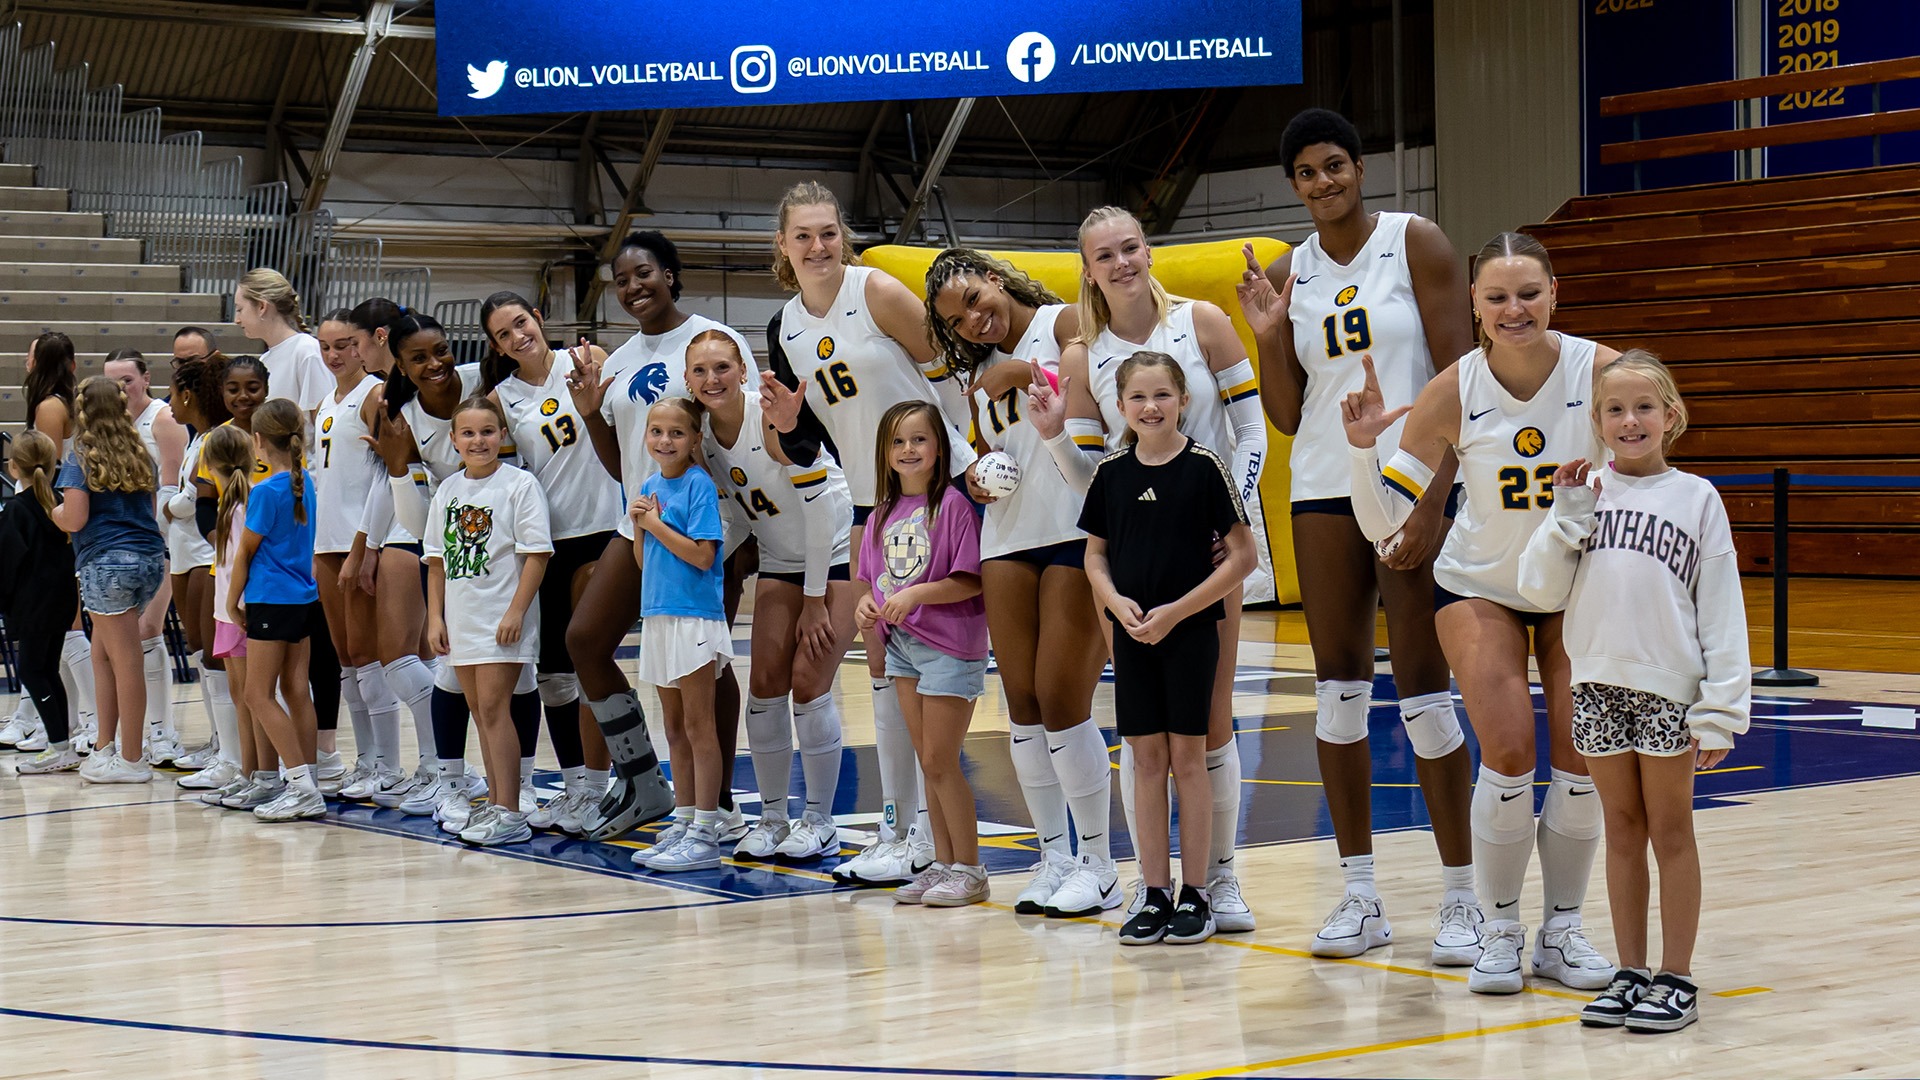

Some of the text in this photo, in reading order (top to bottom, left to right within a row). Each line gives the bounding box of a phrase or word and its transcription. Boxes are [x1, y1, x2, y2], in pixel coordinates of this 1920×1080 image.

[1779, 18, 1840, 48] 2019
[787, 50, 990, 78] @LIONVOLLEYBALL
[1070, 37, 1273, 66] /LIONVOLLEYBALL
[1779, 50, 1839, 75] 2021
[514, 61, 724, 88] @LION_VOLLEYBALL
[1779, 86, 1845, 111] 2022
[1322, 306, 1374, 360] 19
[815, 360, 859, 406] 16
[987, 386, 1021, 436] 17
[540, 413, 579, 454] 13
[321, 437, 332, 469] 7
[1242, 451, 1262, 502] TEXAS
[1497, 463, 1561, 511] 23
[734, 487, 781, 521] 14
